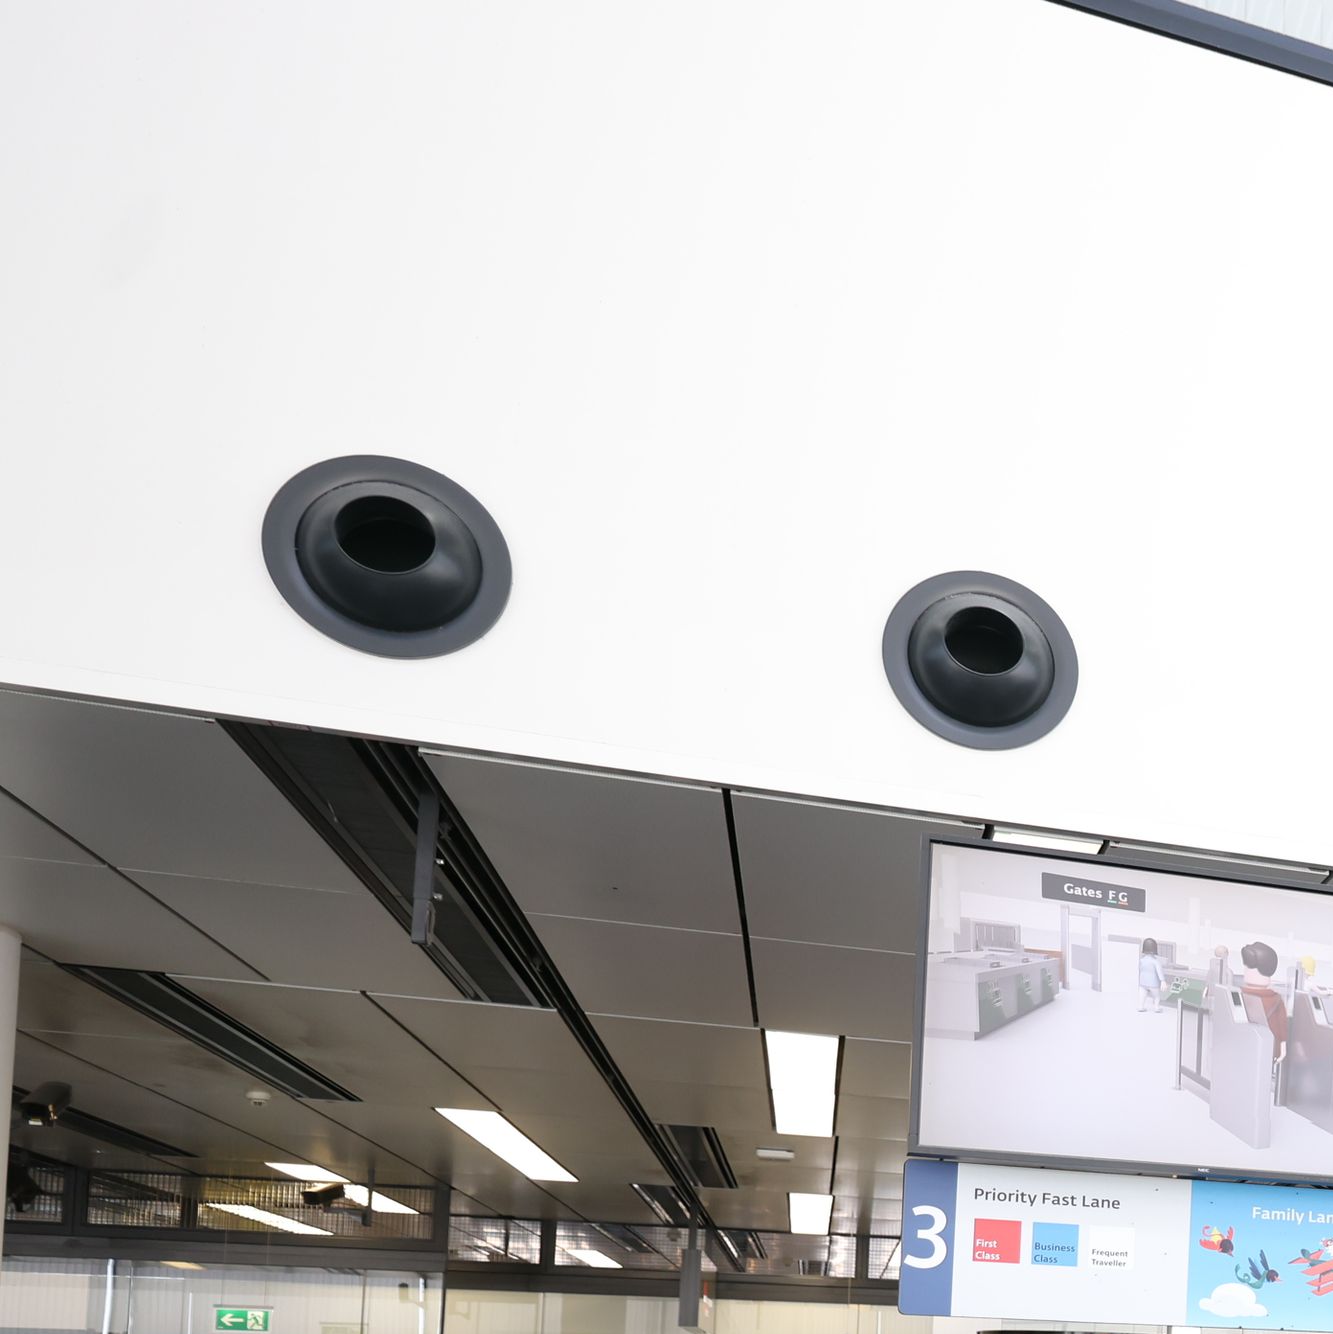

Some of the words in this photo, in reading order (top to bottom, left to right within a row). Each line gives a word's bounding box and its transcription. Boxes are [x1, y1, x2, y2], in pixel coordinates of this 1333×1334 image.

[1063, 883, 1103, 899] Gates
[974, 1187, 1037, 1207] Priority
[1042, 1192, 1077, 1207] Fast
[1082, 1195, 1121, 1210] Lane
[1251, 1206, 1305, 1225] Family
[904, 1205, 947, 1269] 3
[975, 1238, 998, 1249] First
[1034, 1242, 1076, 1253] Business
[974, 1251, 1001, 1261] Class
[1091, 1248, 1129, 1258] Frequent
[1033, 1254, 1058, 1264] Class
[1091, 1259, 1127, 1268] Traveller
